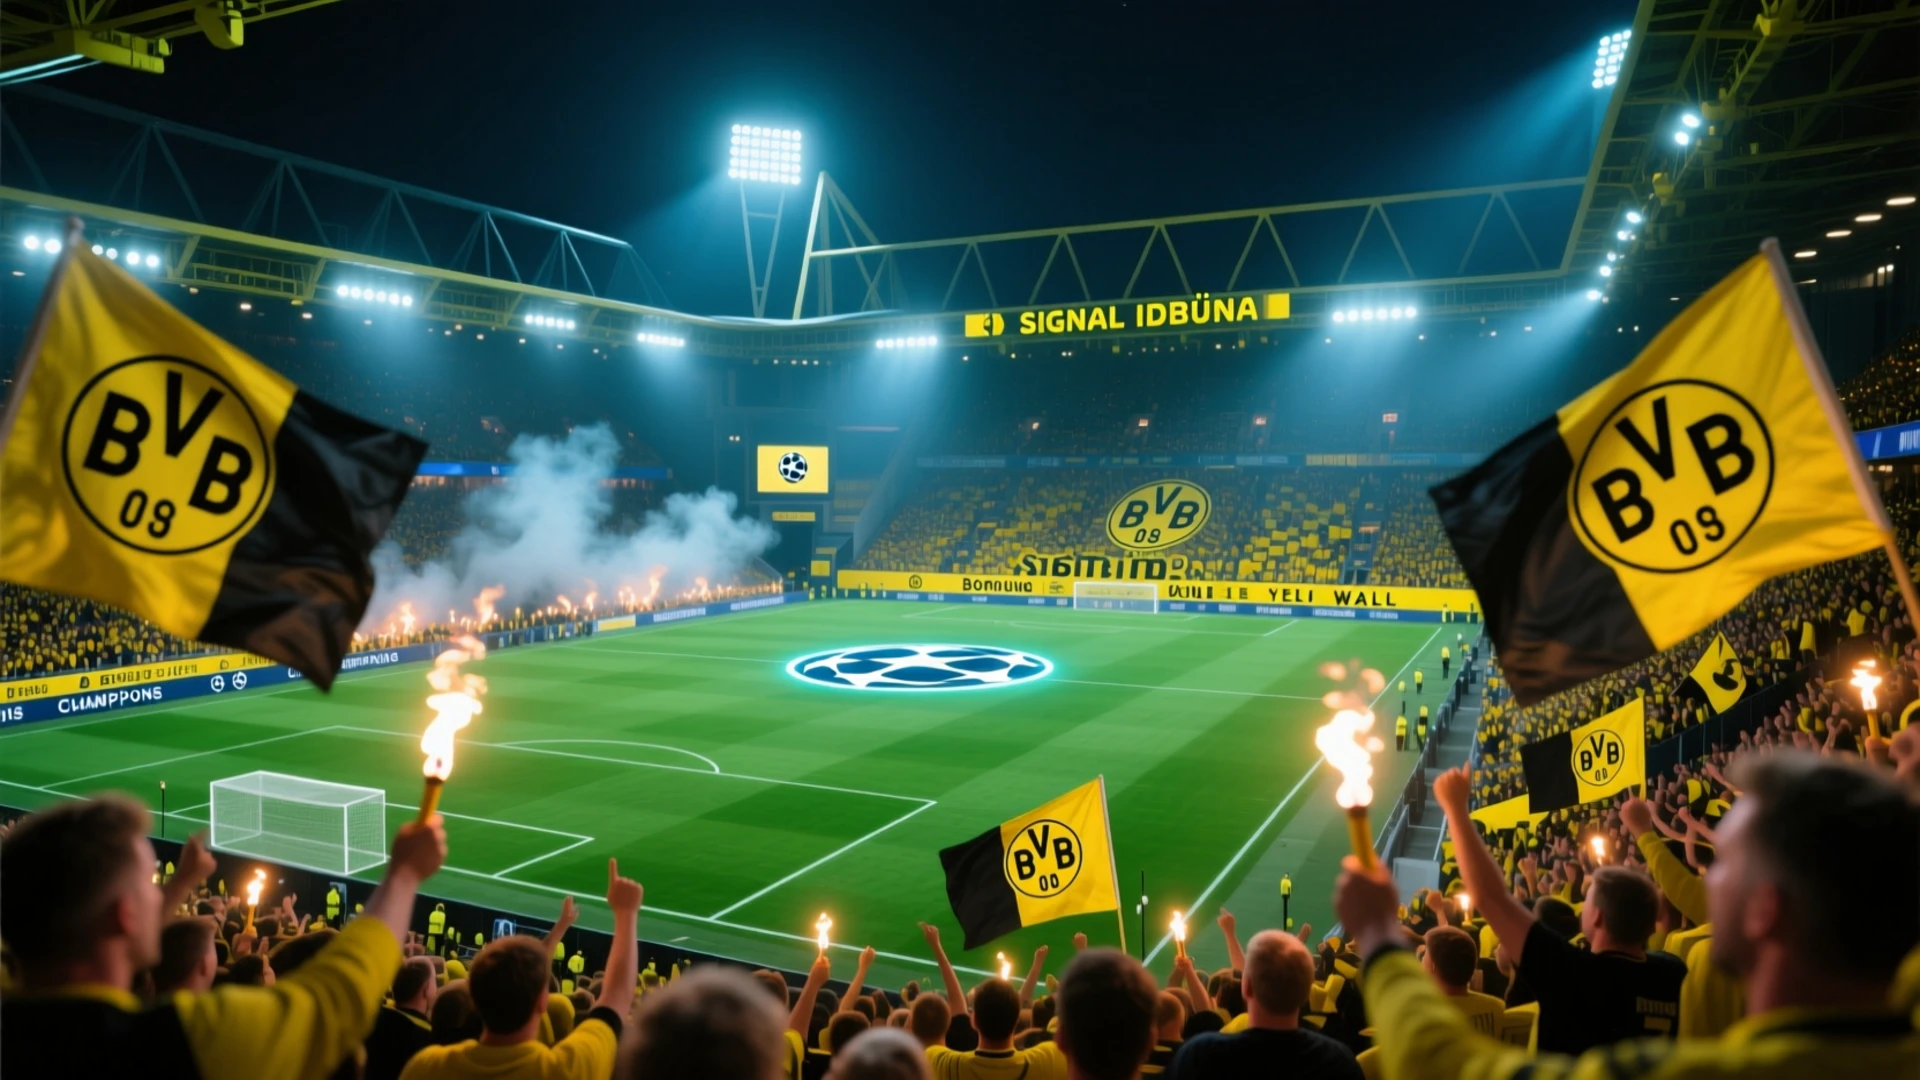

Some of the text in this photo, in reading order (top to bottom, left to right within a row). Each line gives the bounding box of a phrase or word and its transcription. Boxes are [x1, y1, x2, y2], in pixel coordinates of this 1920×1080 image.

[1019, 292, 1259, 335] SIGNAL IDBÜNA
[83, 369, 253, 516] BVB
[1591, 395, 1755, 544] BVB
[1118, 485, 1200, 529] BVB
[1669, 505, 1726, 556] 09
[1333, 590, 1397, 606] WALL
[1580, 733, 1620, 772] BVB
[1013, 824, 1076, 881] BVB
